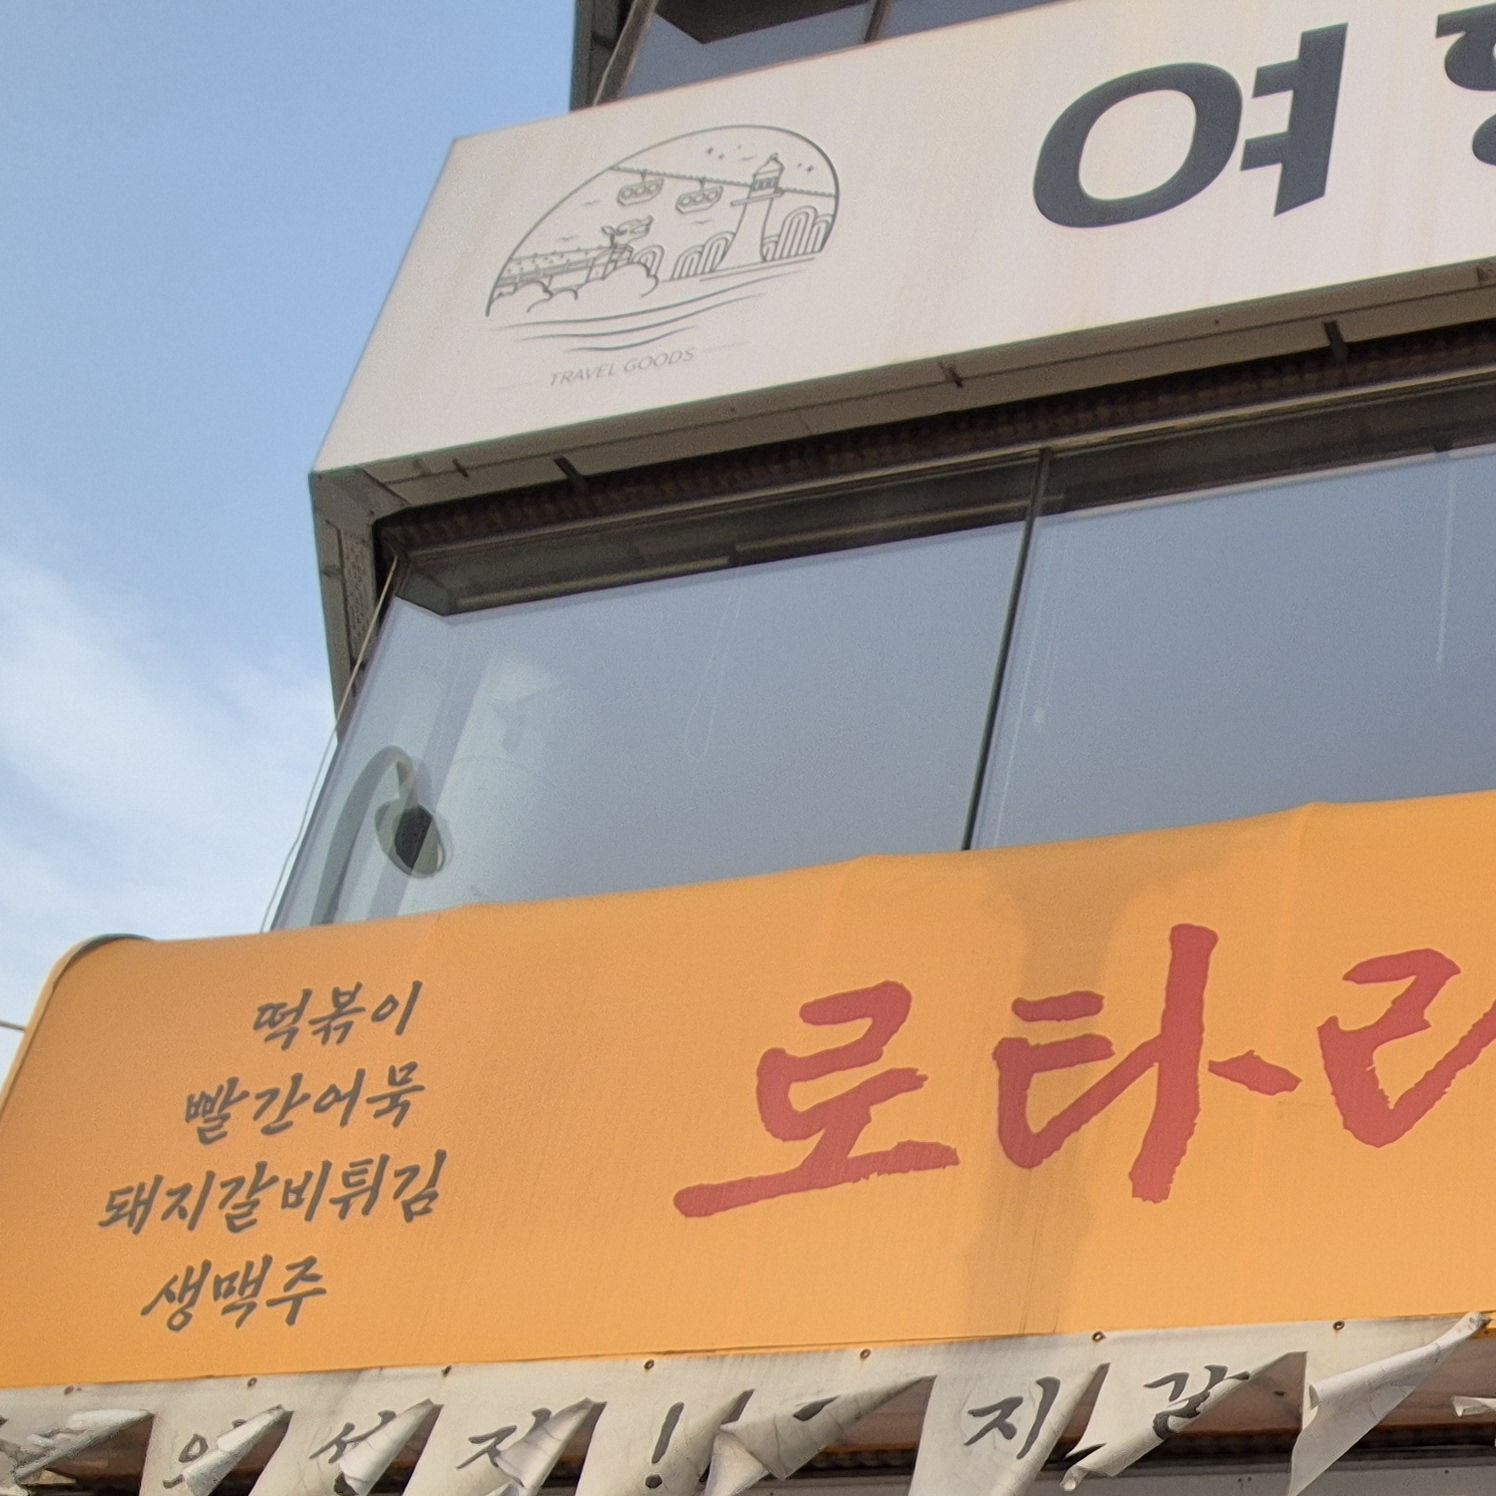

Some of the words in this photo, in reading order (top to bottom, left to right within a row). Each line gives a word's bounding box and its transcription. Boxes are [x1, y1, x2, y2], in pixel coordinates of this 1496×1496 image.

[551, 362, 616, 386] TRAVEL
[624, 346, 697, 373] GOODS
[253, 979, 423, 1051] 떡볶이
[185, 1061, 426, 1145] 빨간어묵
[97, 1149, 447, 1235] 돼지갈비튀김
[141, 1254, 327, 1331] 생맥주
